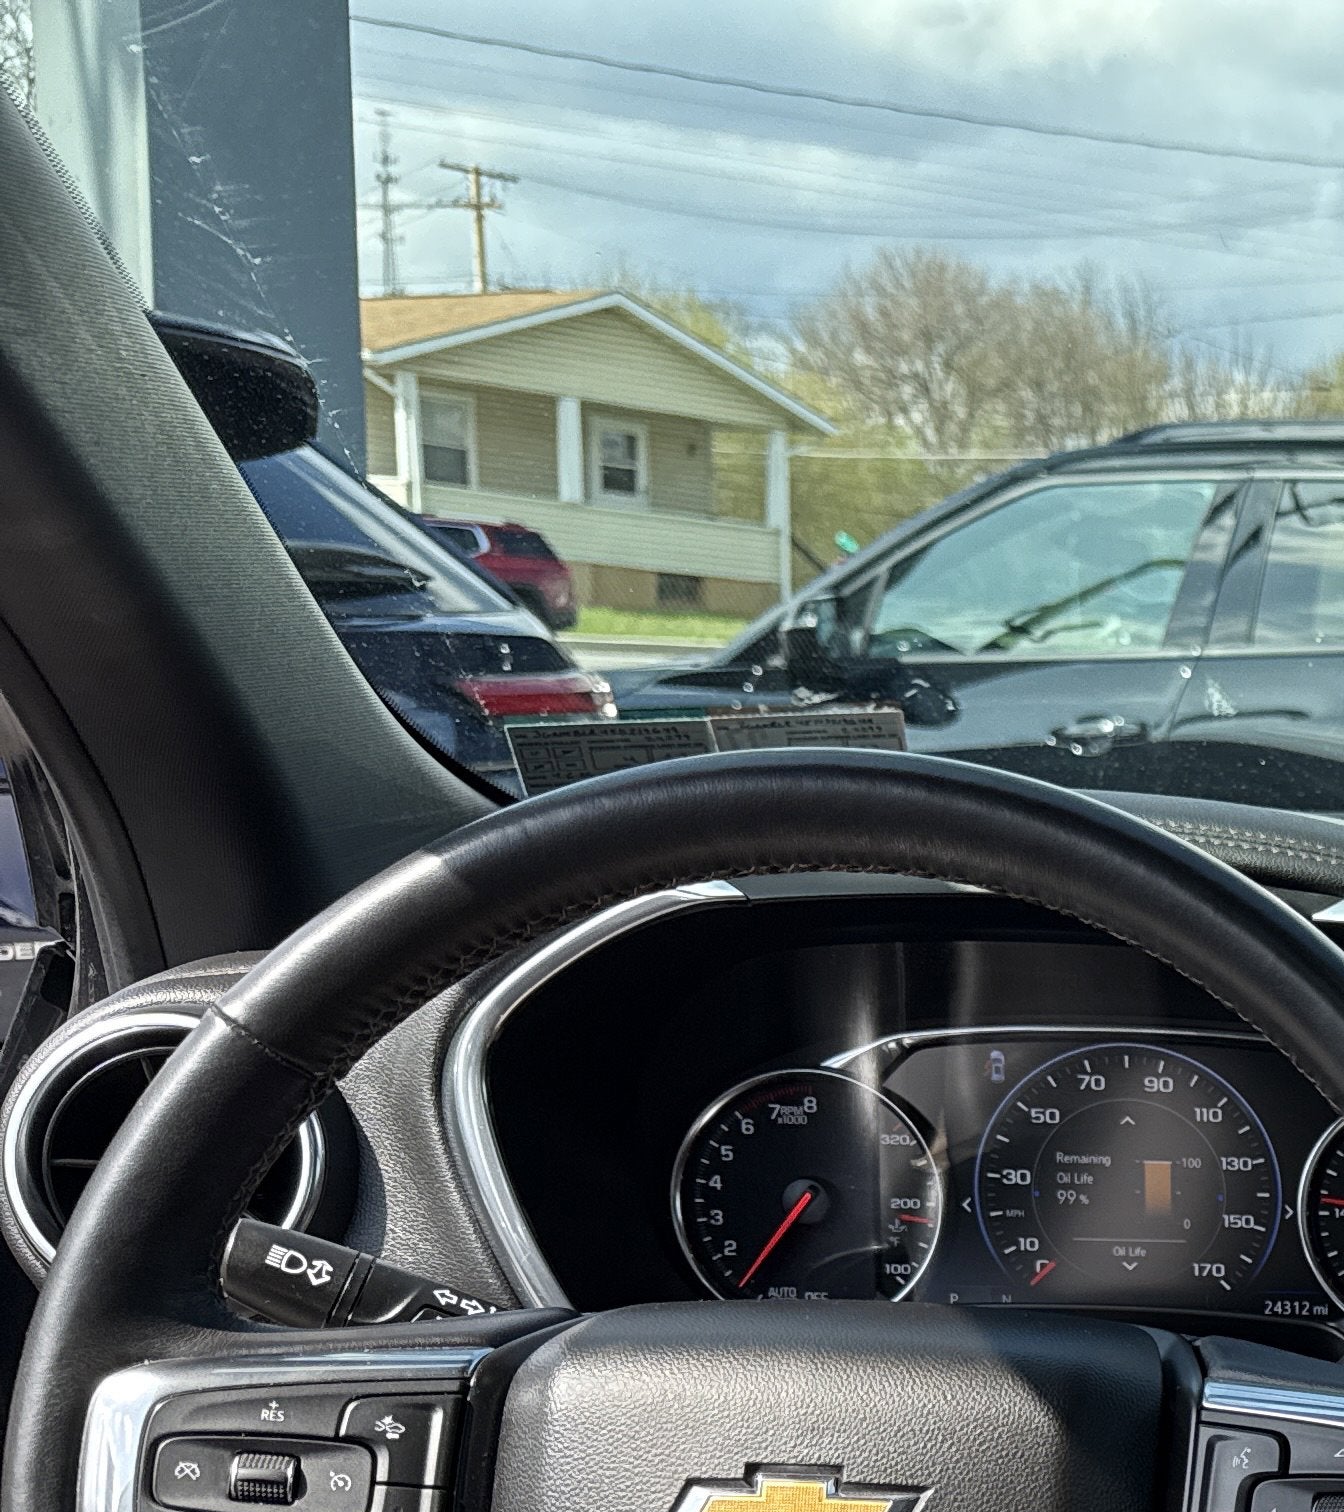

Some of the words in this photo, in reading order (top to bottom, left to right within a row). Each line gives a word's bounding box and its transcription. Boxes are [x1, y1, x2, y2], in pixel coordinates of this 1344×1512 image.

[1076, 1075, 1106, 1091] 70
[1144, 1077, 1174, 1093] 90
[768, 1104, 781, 1120] 7
[803, 1097, 818, 1113] 8
[1030, 1108, 1060, 1124] 50
[1194, 1107, 1223, 1123] 110
[741, 1119, 755, 1135] 6
[880, 1134, 910, 1146] 320
[720, 1145, 734, 1161] 5
[1056, 1152, 1112, 1168] Remaining
[1181, 1157, 1202, 1169] 100
[1220, 1156, 1253, 1171] 130
[708, 1175, 723, 1190] 4
[1002, 1169, 1032, 1185] 30
[1056, 1172, 1071, 1184] Oil
[1074, 1172, 1094, 1185] Life
[890, 1198, 921, 1209] 200
[1056, 1190, 1077, 1205] 99
[709, 1210, 724, 1226] 3
[1005, 1209, 1025, 1217] MPH
[1183, 1218, 1191, 1230] 0
[1222, 1214, 1255, 1229] 150
[723, 1240, 737, 1256] 2
[1018, 1237, 1040, 1251] 10
[1112, 1246, 1127, 1257] Oil
[1129, 1247, 1147, 1258] Life
[884, 1263, 911, 1275] 100
[1193, 1263, 1226, 1277] 170
[768, 1287, 797, 1298] AUTO
[950, 1293, 959, 1304] P
[1002, 1294, 1012, 1304] N
[1264, 1300, 1310, 1316] 24312
[1312, 1303, 1329, 1316] mi
[260, 1408, 285, 1422] RES
